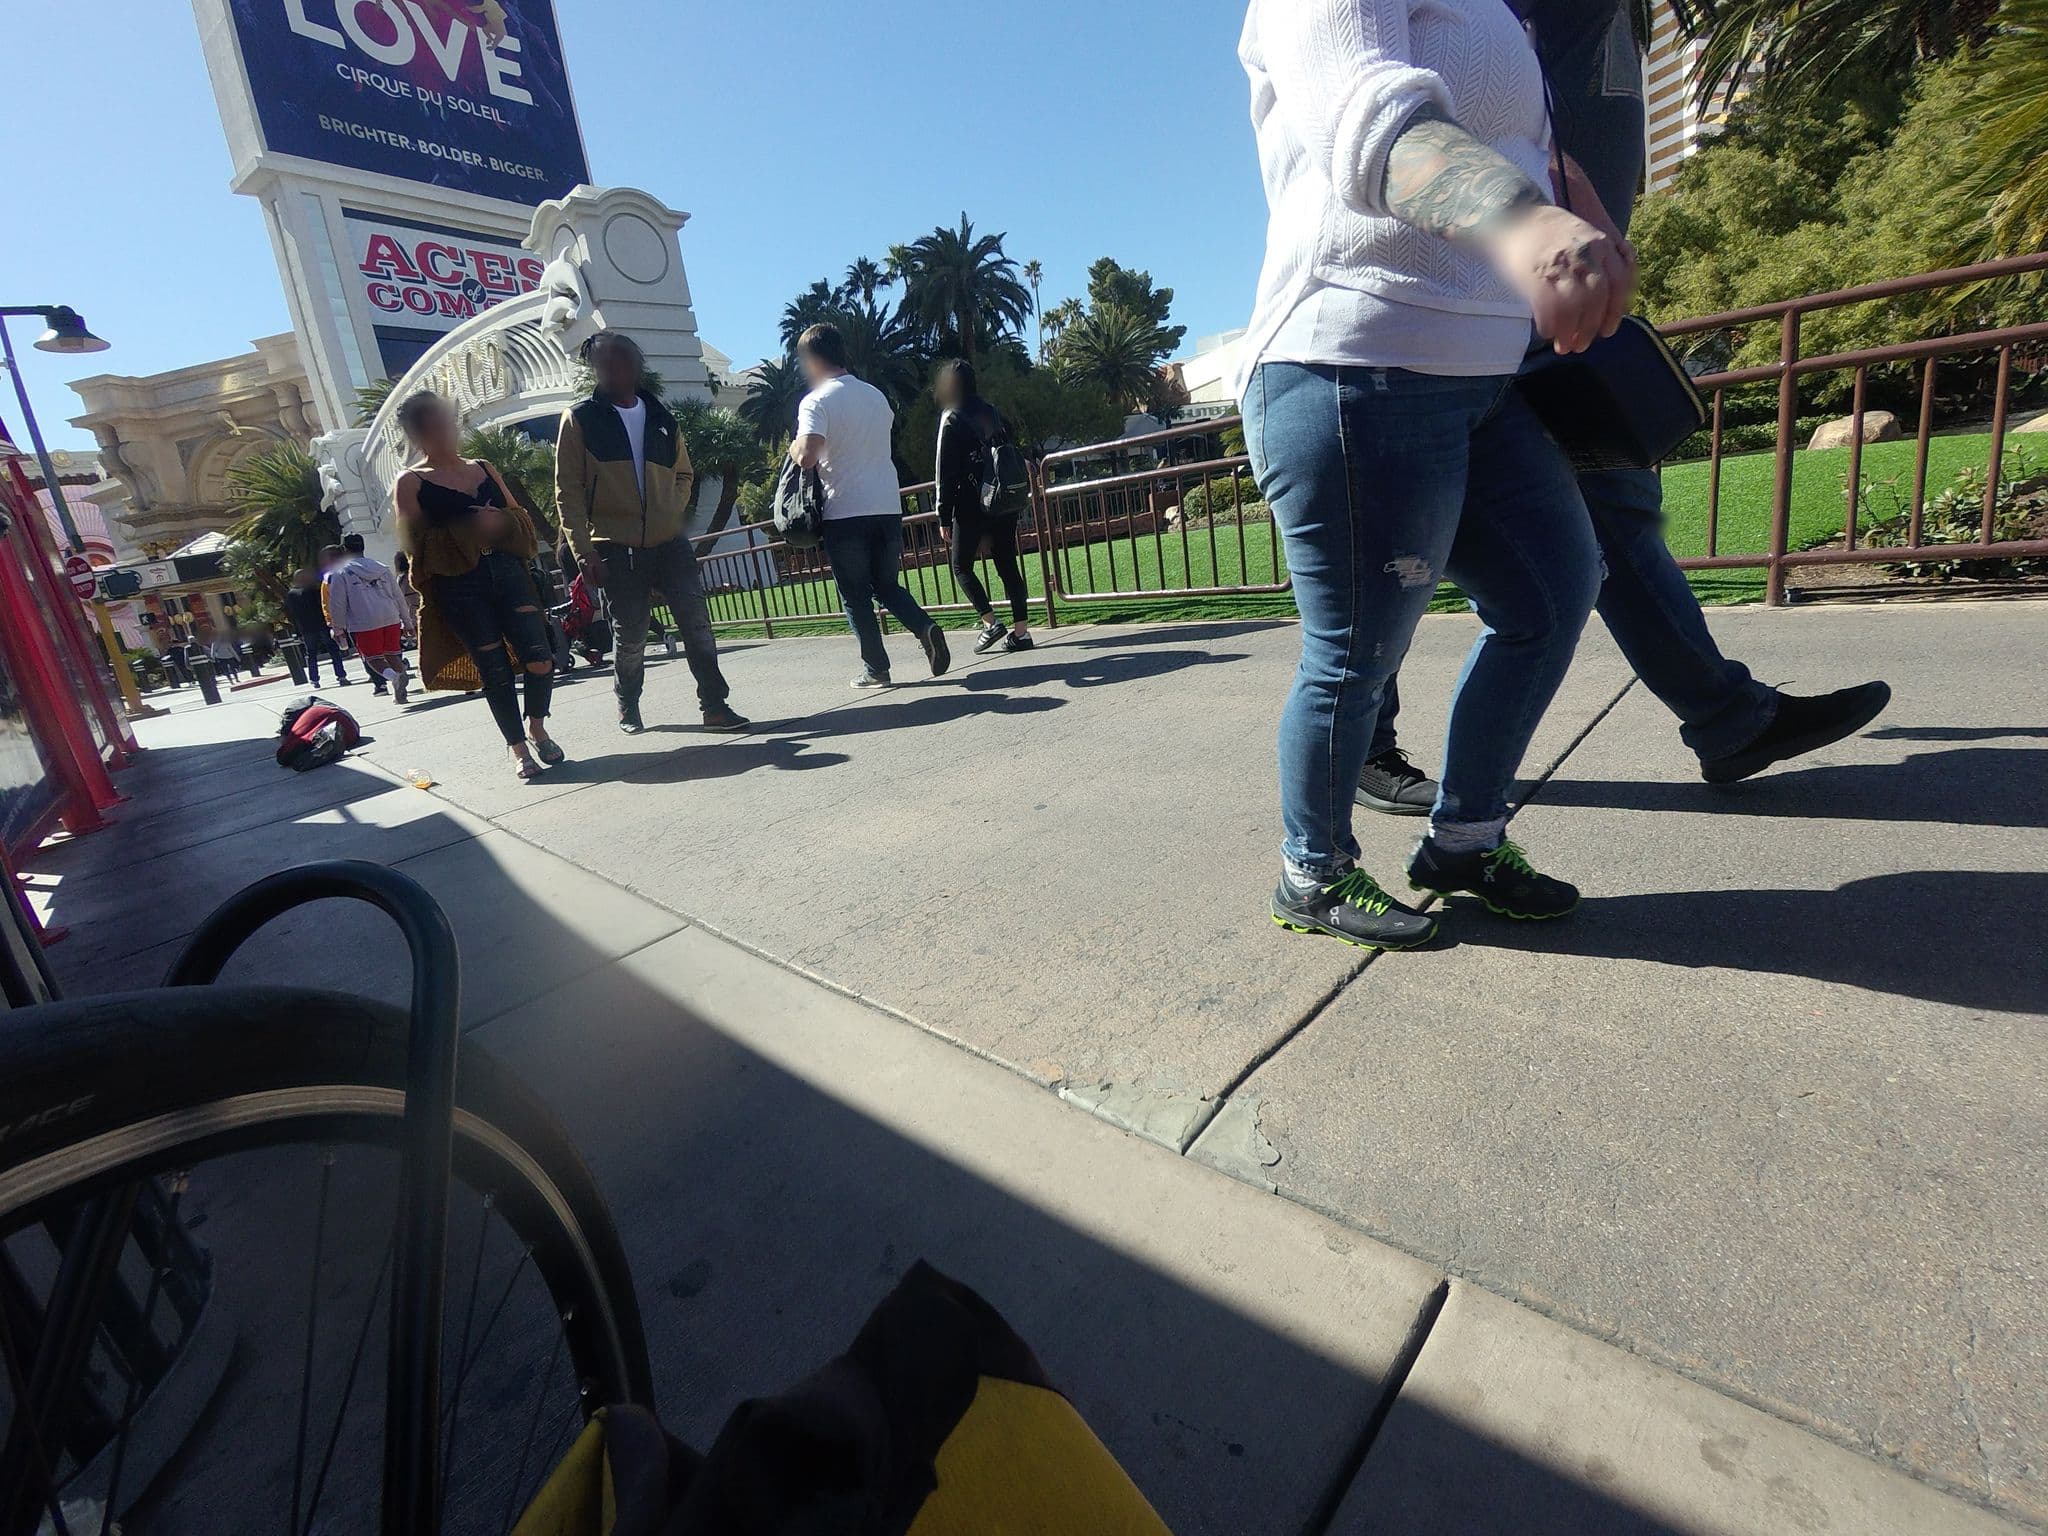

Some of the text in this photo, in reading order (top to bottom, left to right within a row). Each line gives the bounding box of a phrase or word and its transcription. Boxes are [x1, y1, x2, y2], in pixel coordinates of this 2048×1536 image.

[283, 0, 533, 106] LOVE
[336, 63, 507, 125] CIRQUE DU SOLEIL
[318, 114, 548, 183] BRIGHTER. BOLDER. BIGGER.
[359, 233, 546, 296] ACES
[467, 286, 482, 302] of
[367, 282, 503, 320] COM
